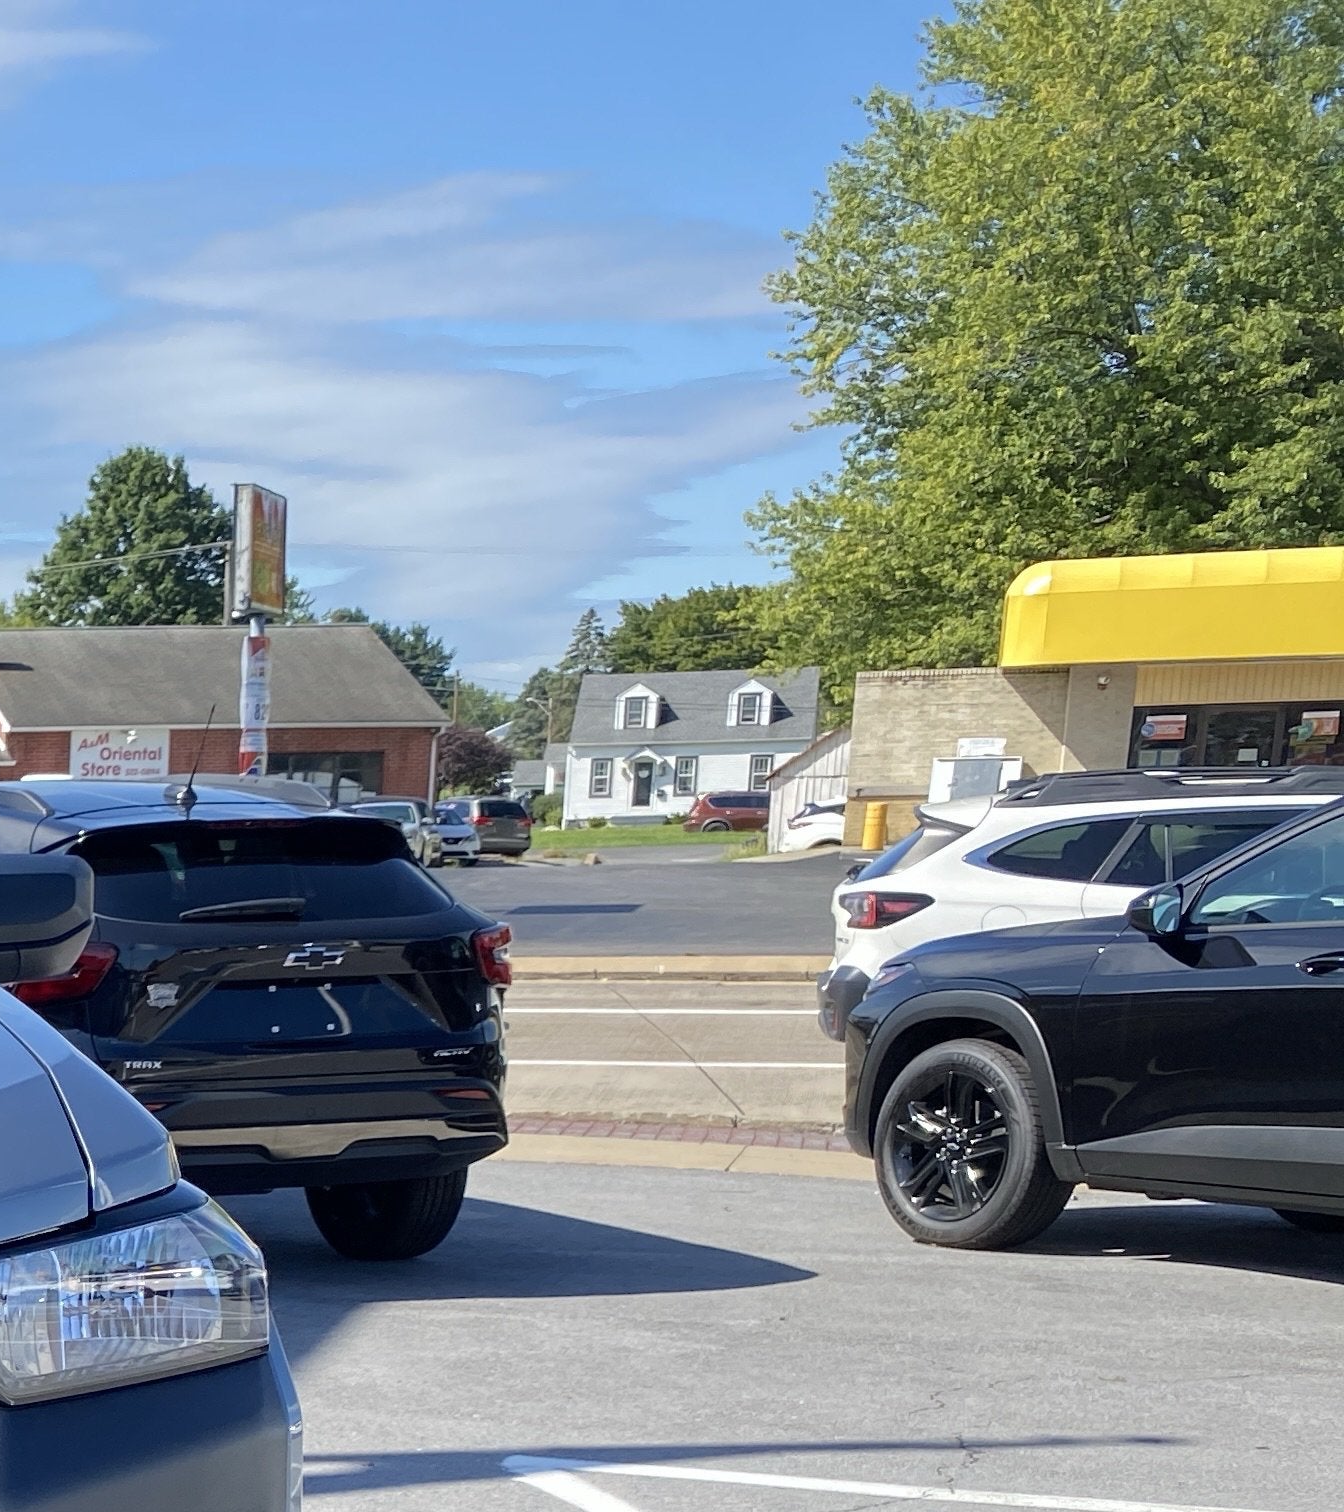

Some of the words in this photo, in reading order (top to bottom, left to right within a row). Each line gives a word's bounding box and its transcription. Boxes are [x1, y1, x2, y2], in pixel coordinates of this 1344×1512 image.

[100, 746, 162, 761] Oriental
[80, 762, 121, 777] Store
[123, 1060, 162, 1069] TRAX
